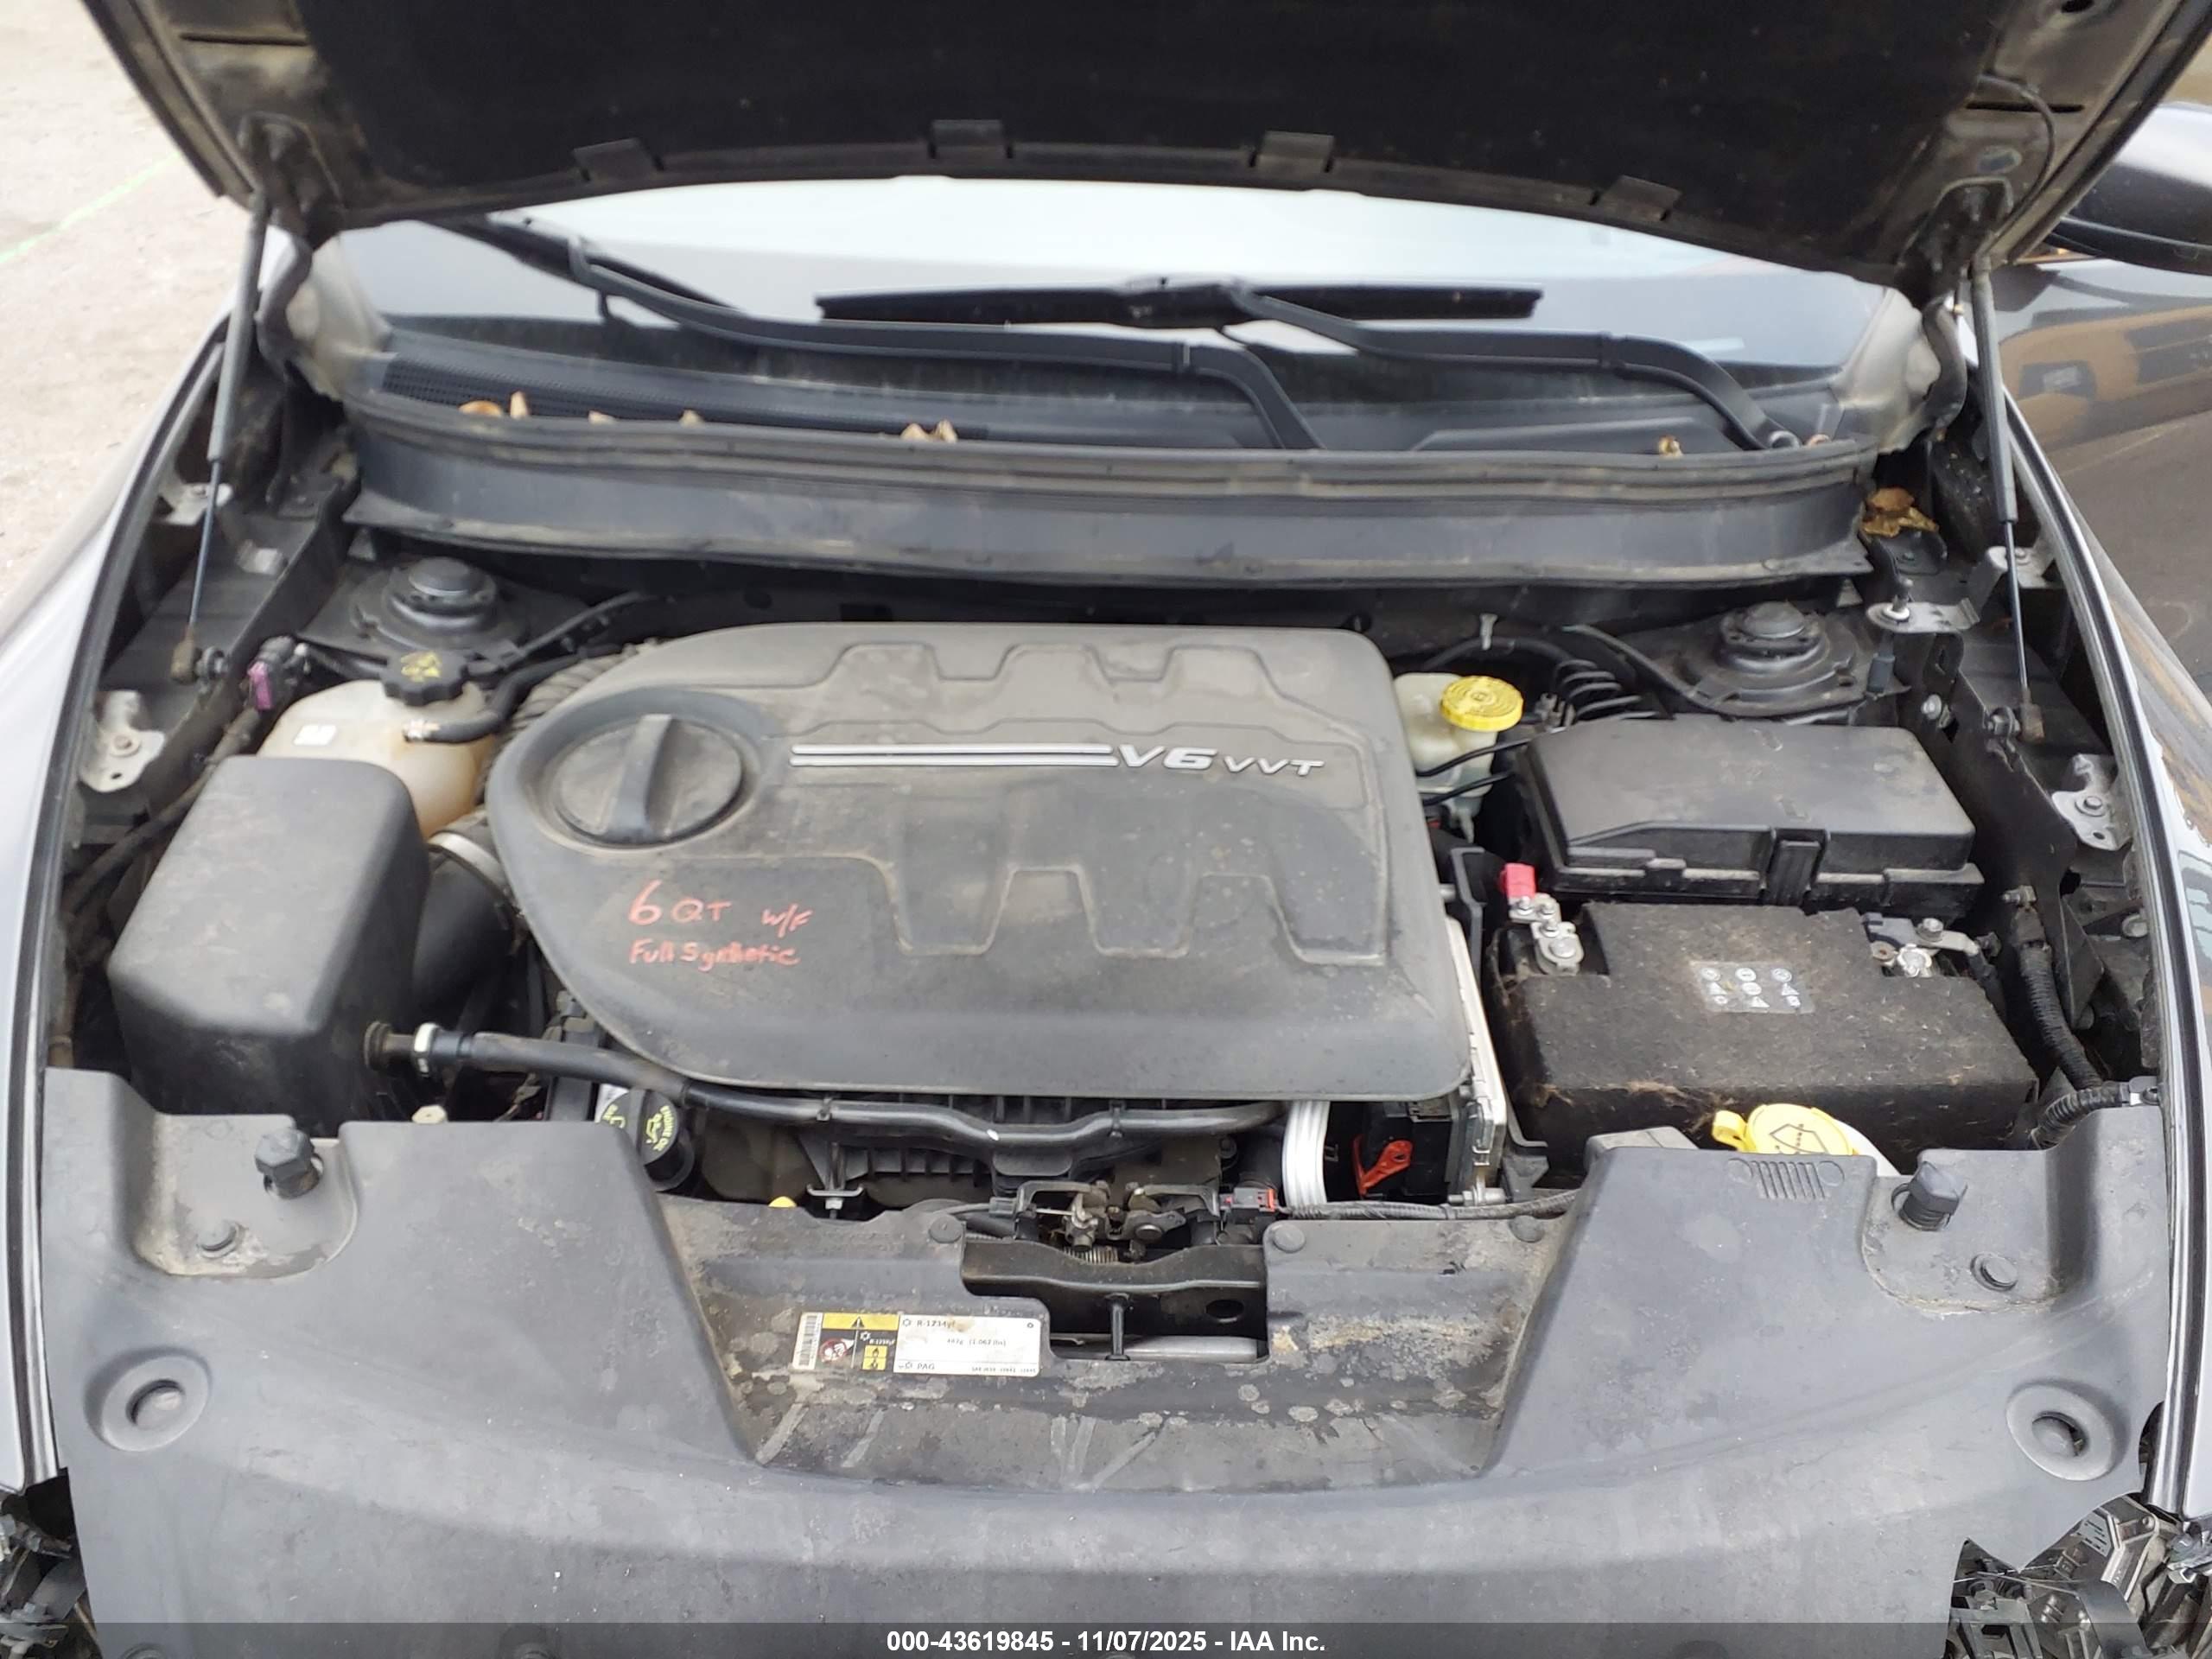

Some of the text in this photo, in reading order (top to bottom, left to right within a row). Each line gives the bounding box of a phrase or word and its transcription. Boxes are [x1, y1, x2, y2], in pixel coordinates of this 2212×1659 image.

[1119, 744, 1325, 776] V6 VVT
[628, 879, 663, 926] 6
[917, 1362, 935, 1370] PAG
